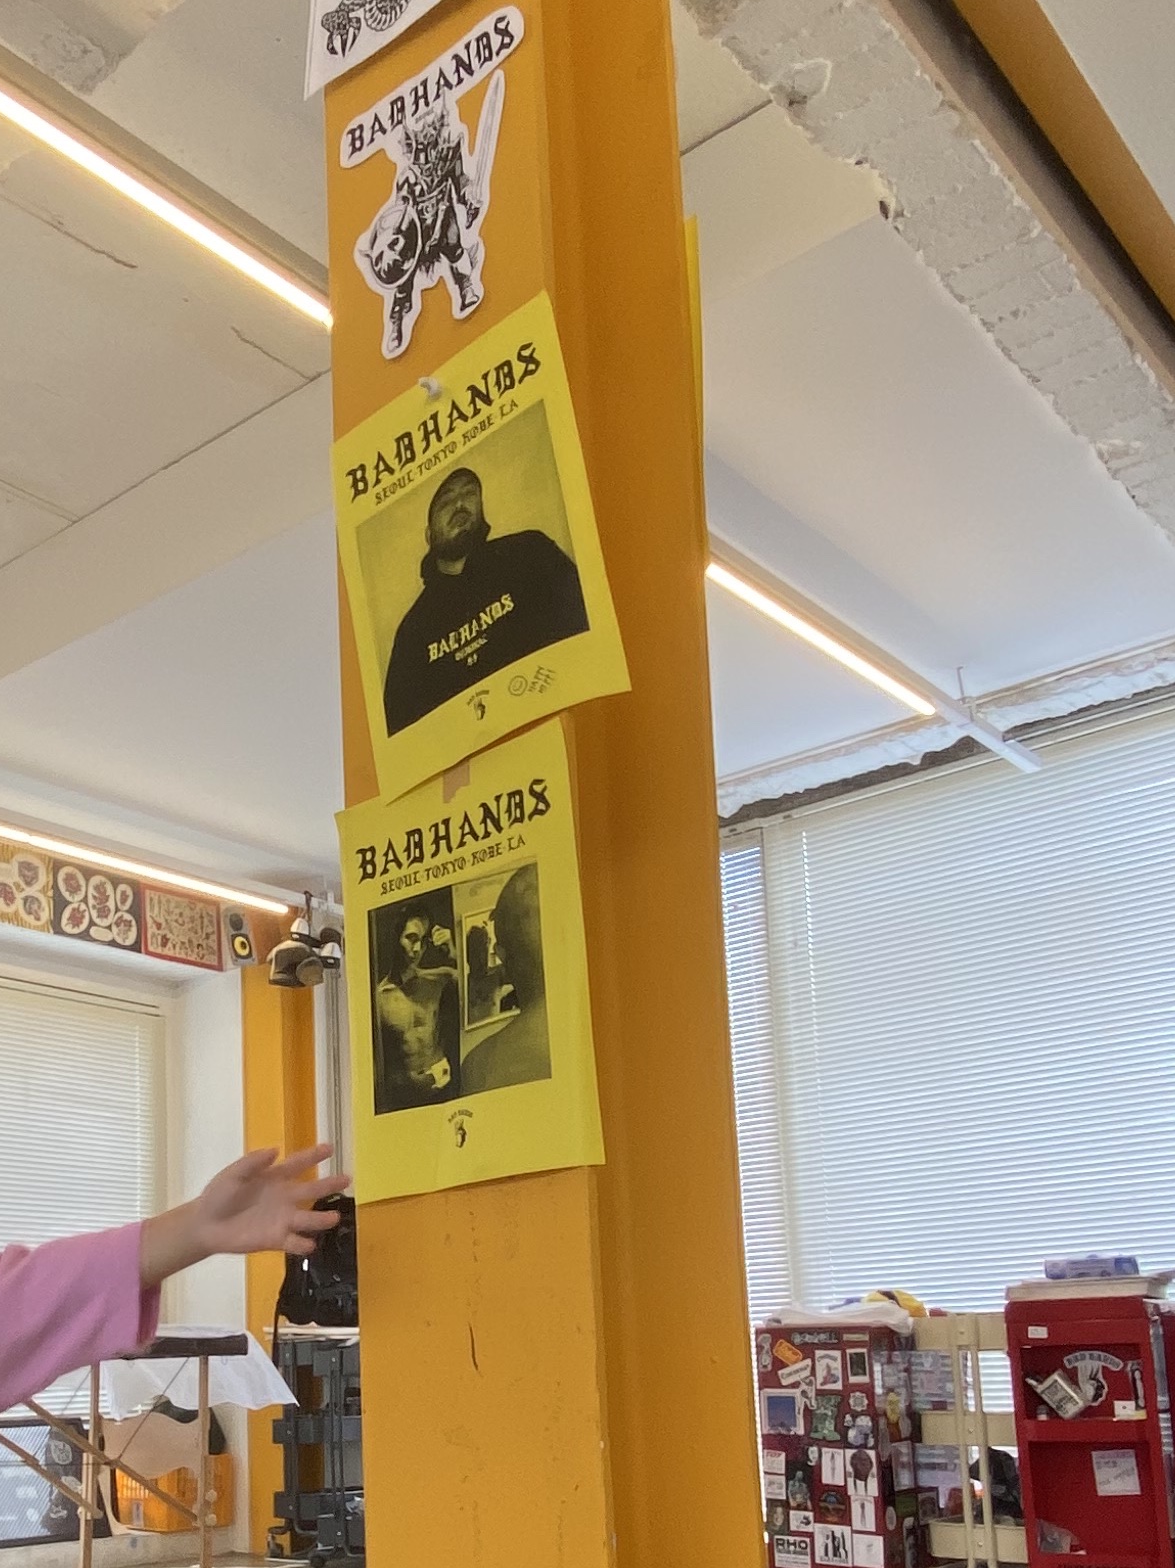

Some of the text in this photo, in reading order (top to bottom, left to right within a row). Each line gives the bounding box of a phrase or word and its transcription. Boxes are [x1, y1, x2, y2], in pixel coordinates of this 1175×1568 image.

[375, 399, 519, 506] SEOUL TOKYO KOBE LA
[380, 834, 526, 897] SEOUL TOKYO KOBE LA
